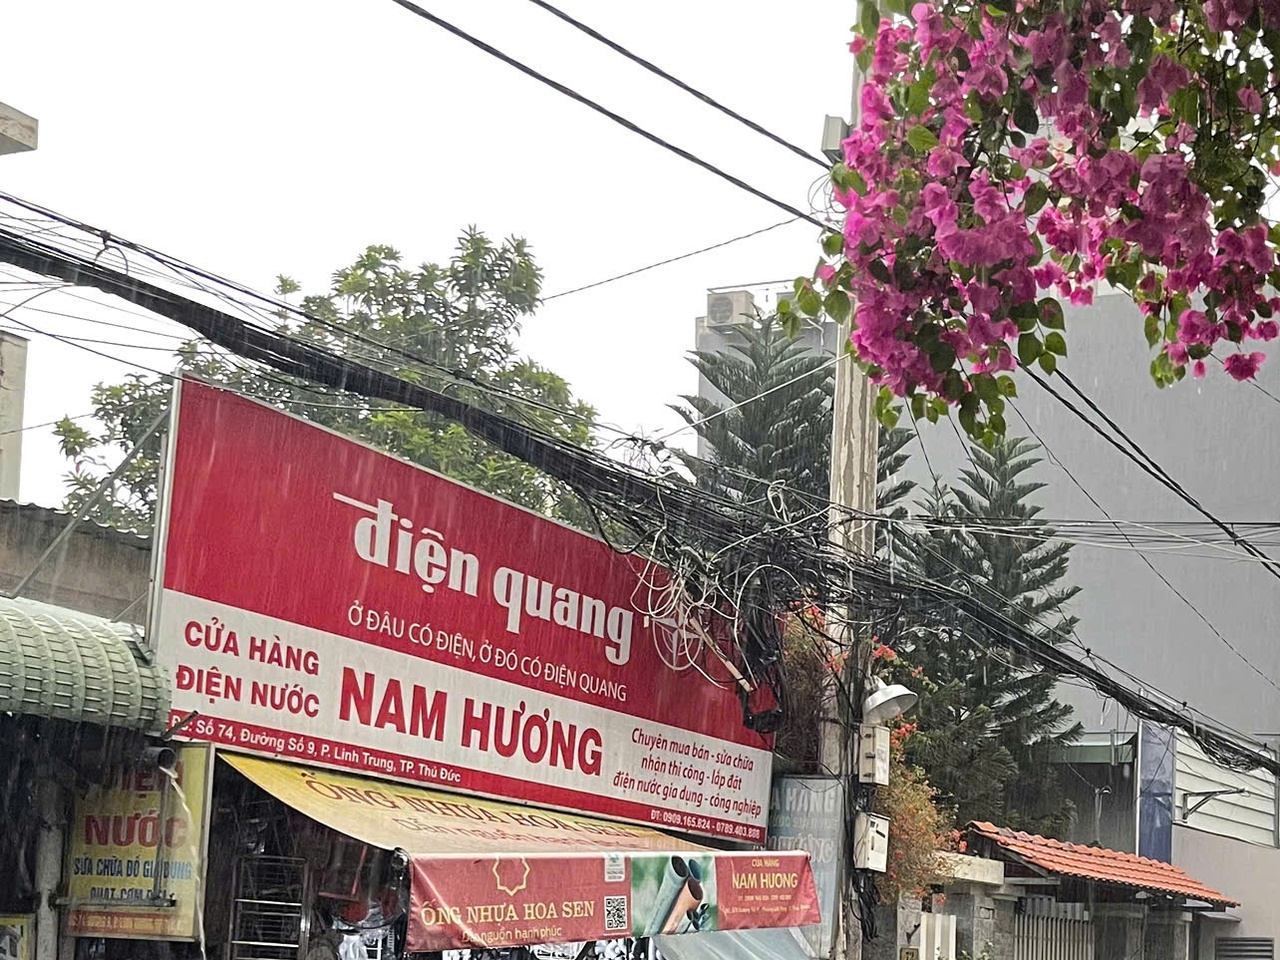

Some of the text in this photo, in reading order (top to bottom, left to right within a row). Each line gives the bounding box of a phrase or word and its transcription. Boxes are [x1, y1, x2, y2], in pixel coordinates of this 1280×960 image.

[333, 492, 634, 666] điện quang
[184, 617, 320, 676] CỬA HÀNG
[348, 600, 628, 702] Ở ĐÂU CÓ ĐIỆN, Ở ĐÓ CÓ ĐIỆN QUANG
[175, 664, 320, 718] ĐIỆN NƯỚC
[339, 666, 604, 778] NAM HƯƠNG
[195, 719, 214, 736] Số
[217, 724, 236, 742] 74,
[240, 728, 285, 753] Đường
[288, 734, 305, 753] Số
[306, 742, 318, 758] 9,
[321, 745, 332, 760] P.
[333, 748, 359, 764] Linh
[362, 752, 397, 773] Trung,
[399, 759, 416, 775] TP.
[418, 762, 438, 780] Thủ
[439, 766, 461, 783] Đức
[631, 728, 668, 751] Chuyên
[670, 743, 691, 757] mua
[692, 741, 709, 761] bán
[716, 750, 731, 766] sửa
[733, 757, 754, 772] chữa
[641, 755, 667, 776] nhận
[668, 760, 681, 775] thi
[682, 765, 705, 786] công
[711, 769, 726, 790] lắp
[727, 774, 742, 793] đặt
[613, 770, 635, 793] điện
[636, 778, 661, 796] nước
[662, 784, 677, 800] gia
[679, 786, 704, 808] dụng
[709, 793, 731, 814] công
[733, 797, 762, 819] nghiệp
[732, 873, 758, 889] NAM
[466, 902, 519, 926] NHỰA
[523, 903, 558, 920] HOA
[561, 901, 596, 918] SEN
